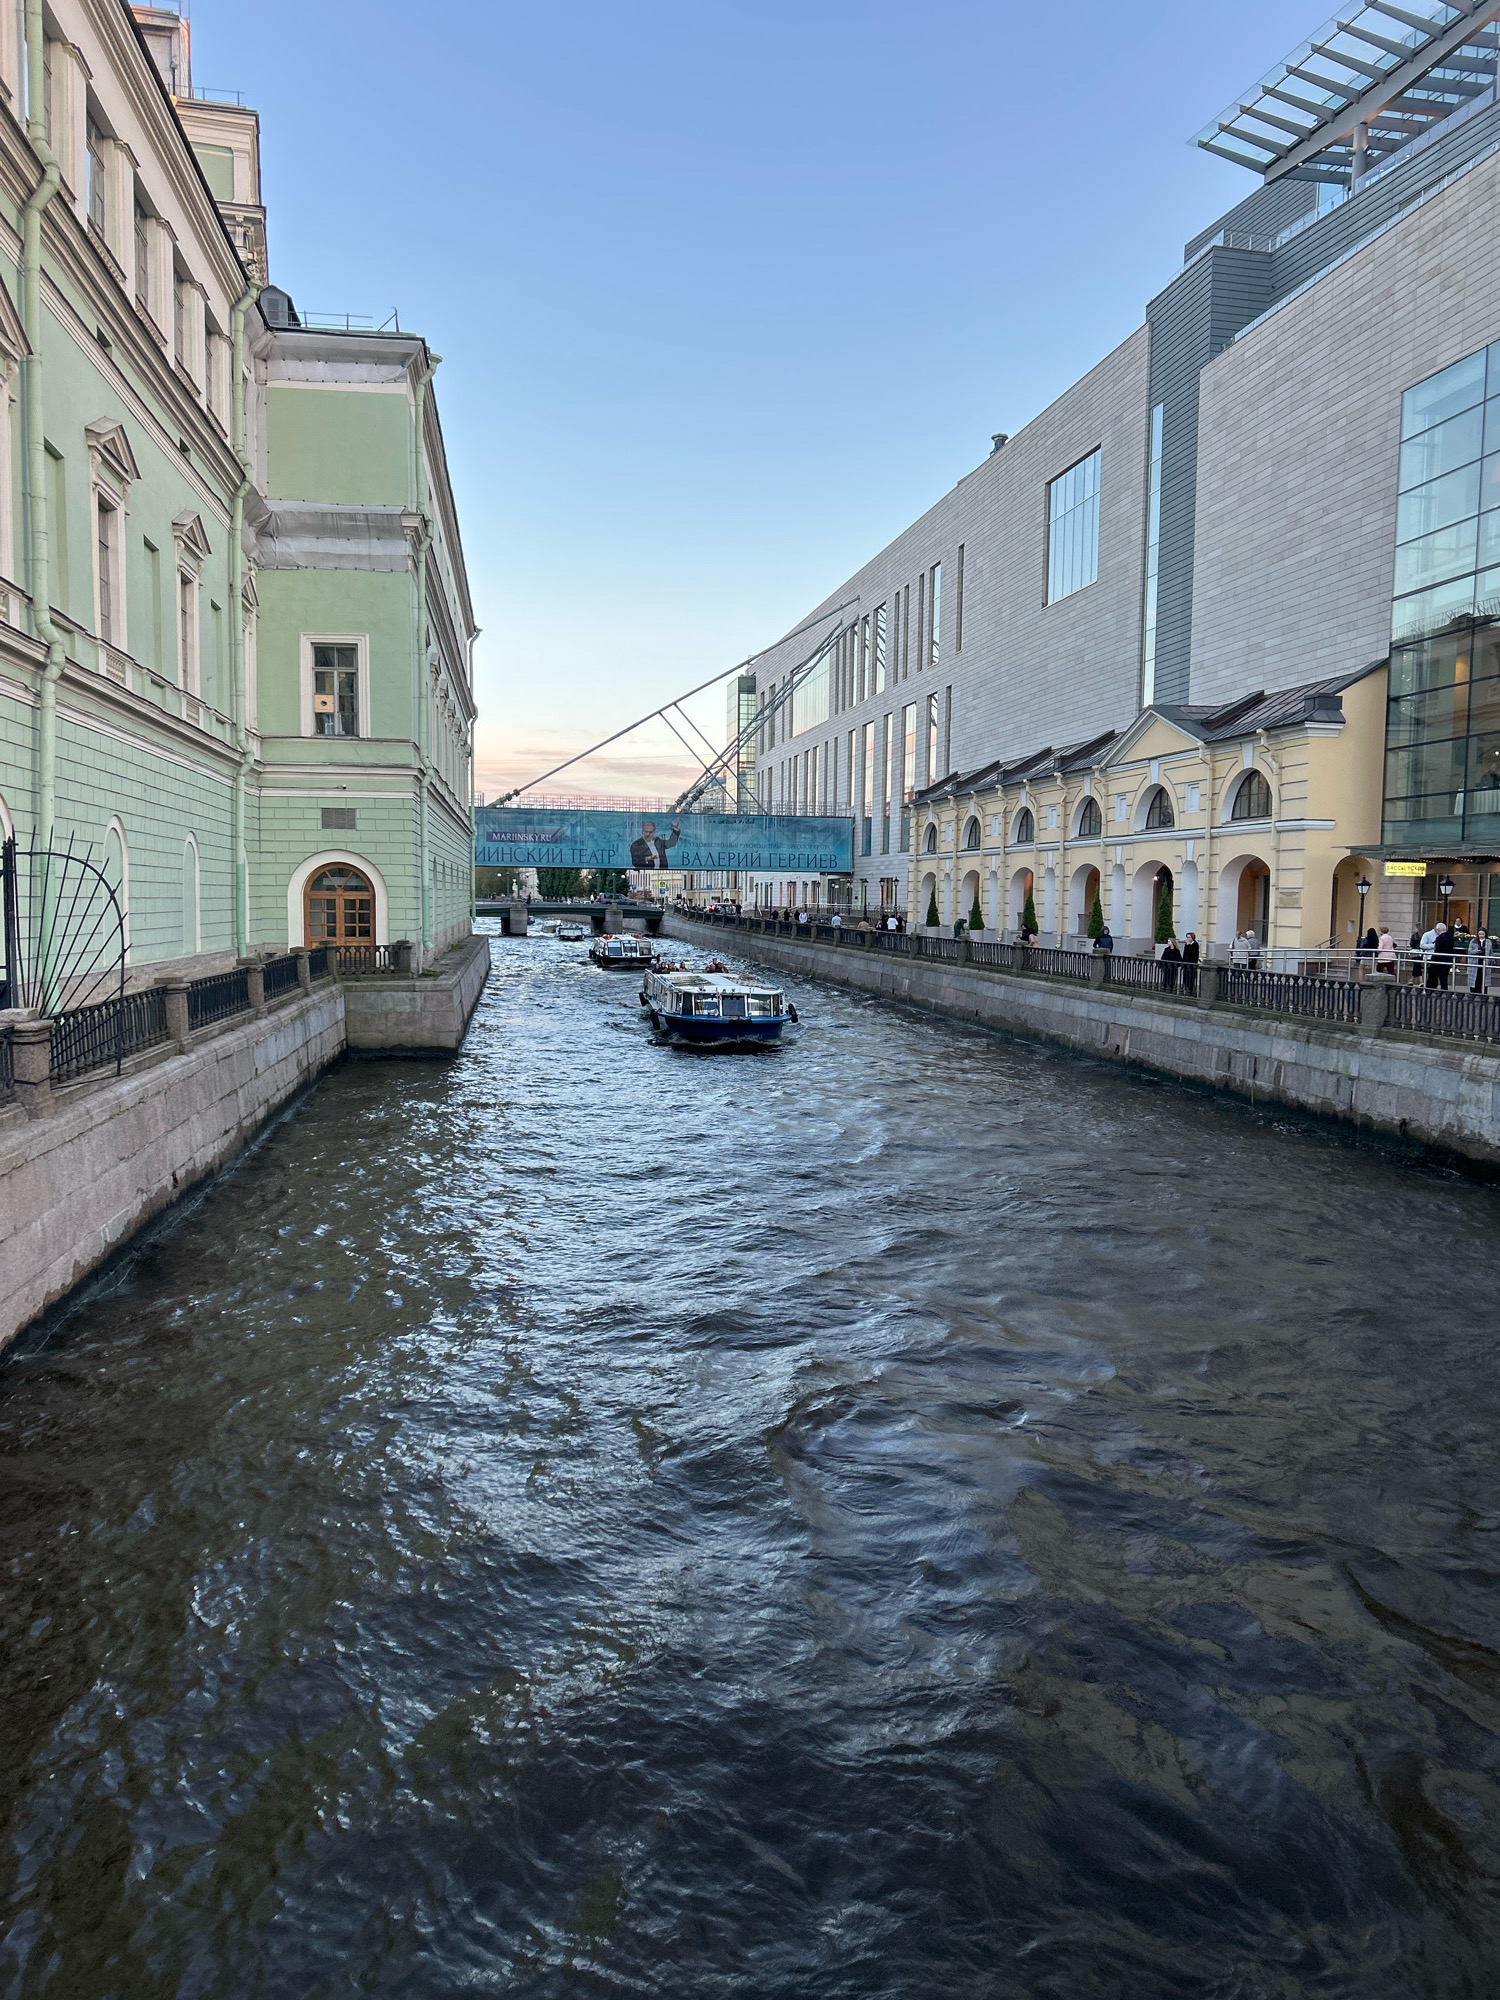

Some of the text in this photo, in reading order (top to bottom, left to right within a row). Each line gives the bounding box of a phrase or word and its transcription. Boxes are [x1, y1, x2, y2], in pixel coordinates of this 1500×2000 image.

[492, 832, 552, 842] MARIINSKY.RU
[568, 848, 616, 864] ТЕАТР
[681, 850, 838, 869] ВАЛЕРИЙ ГЕРГИЕВ
